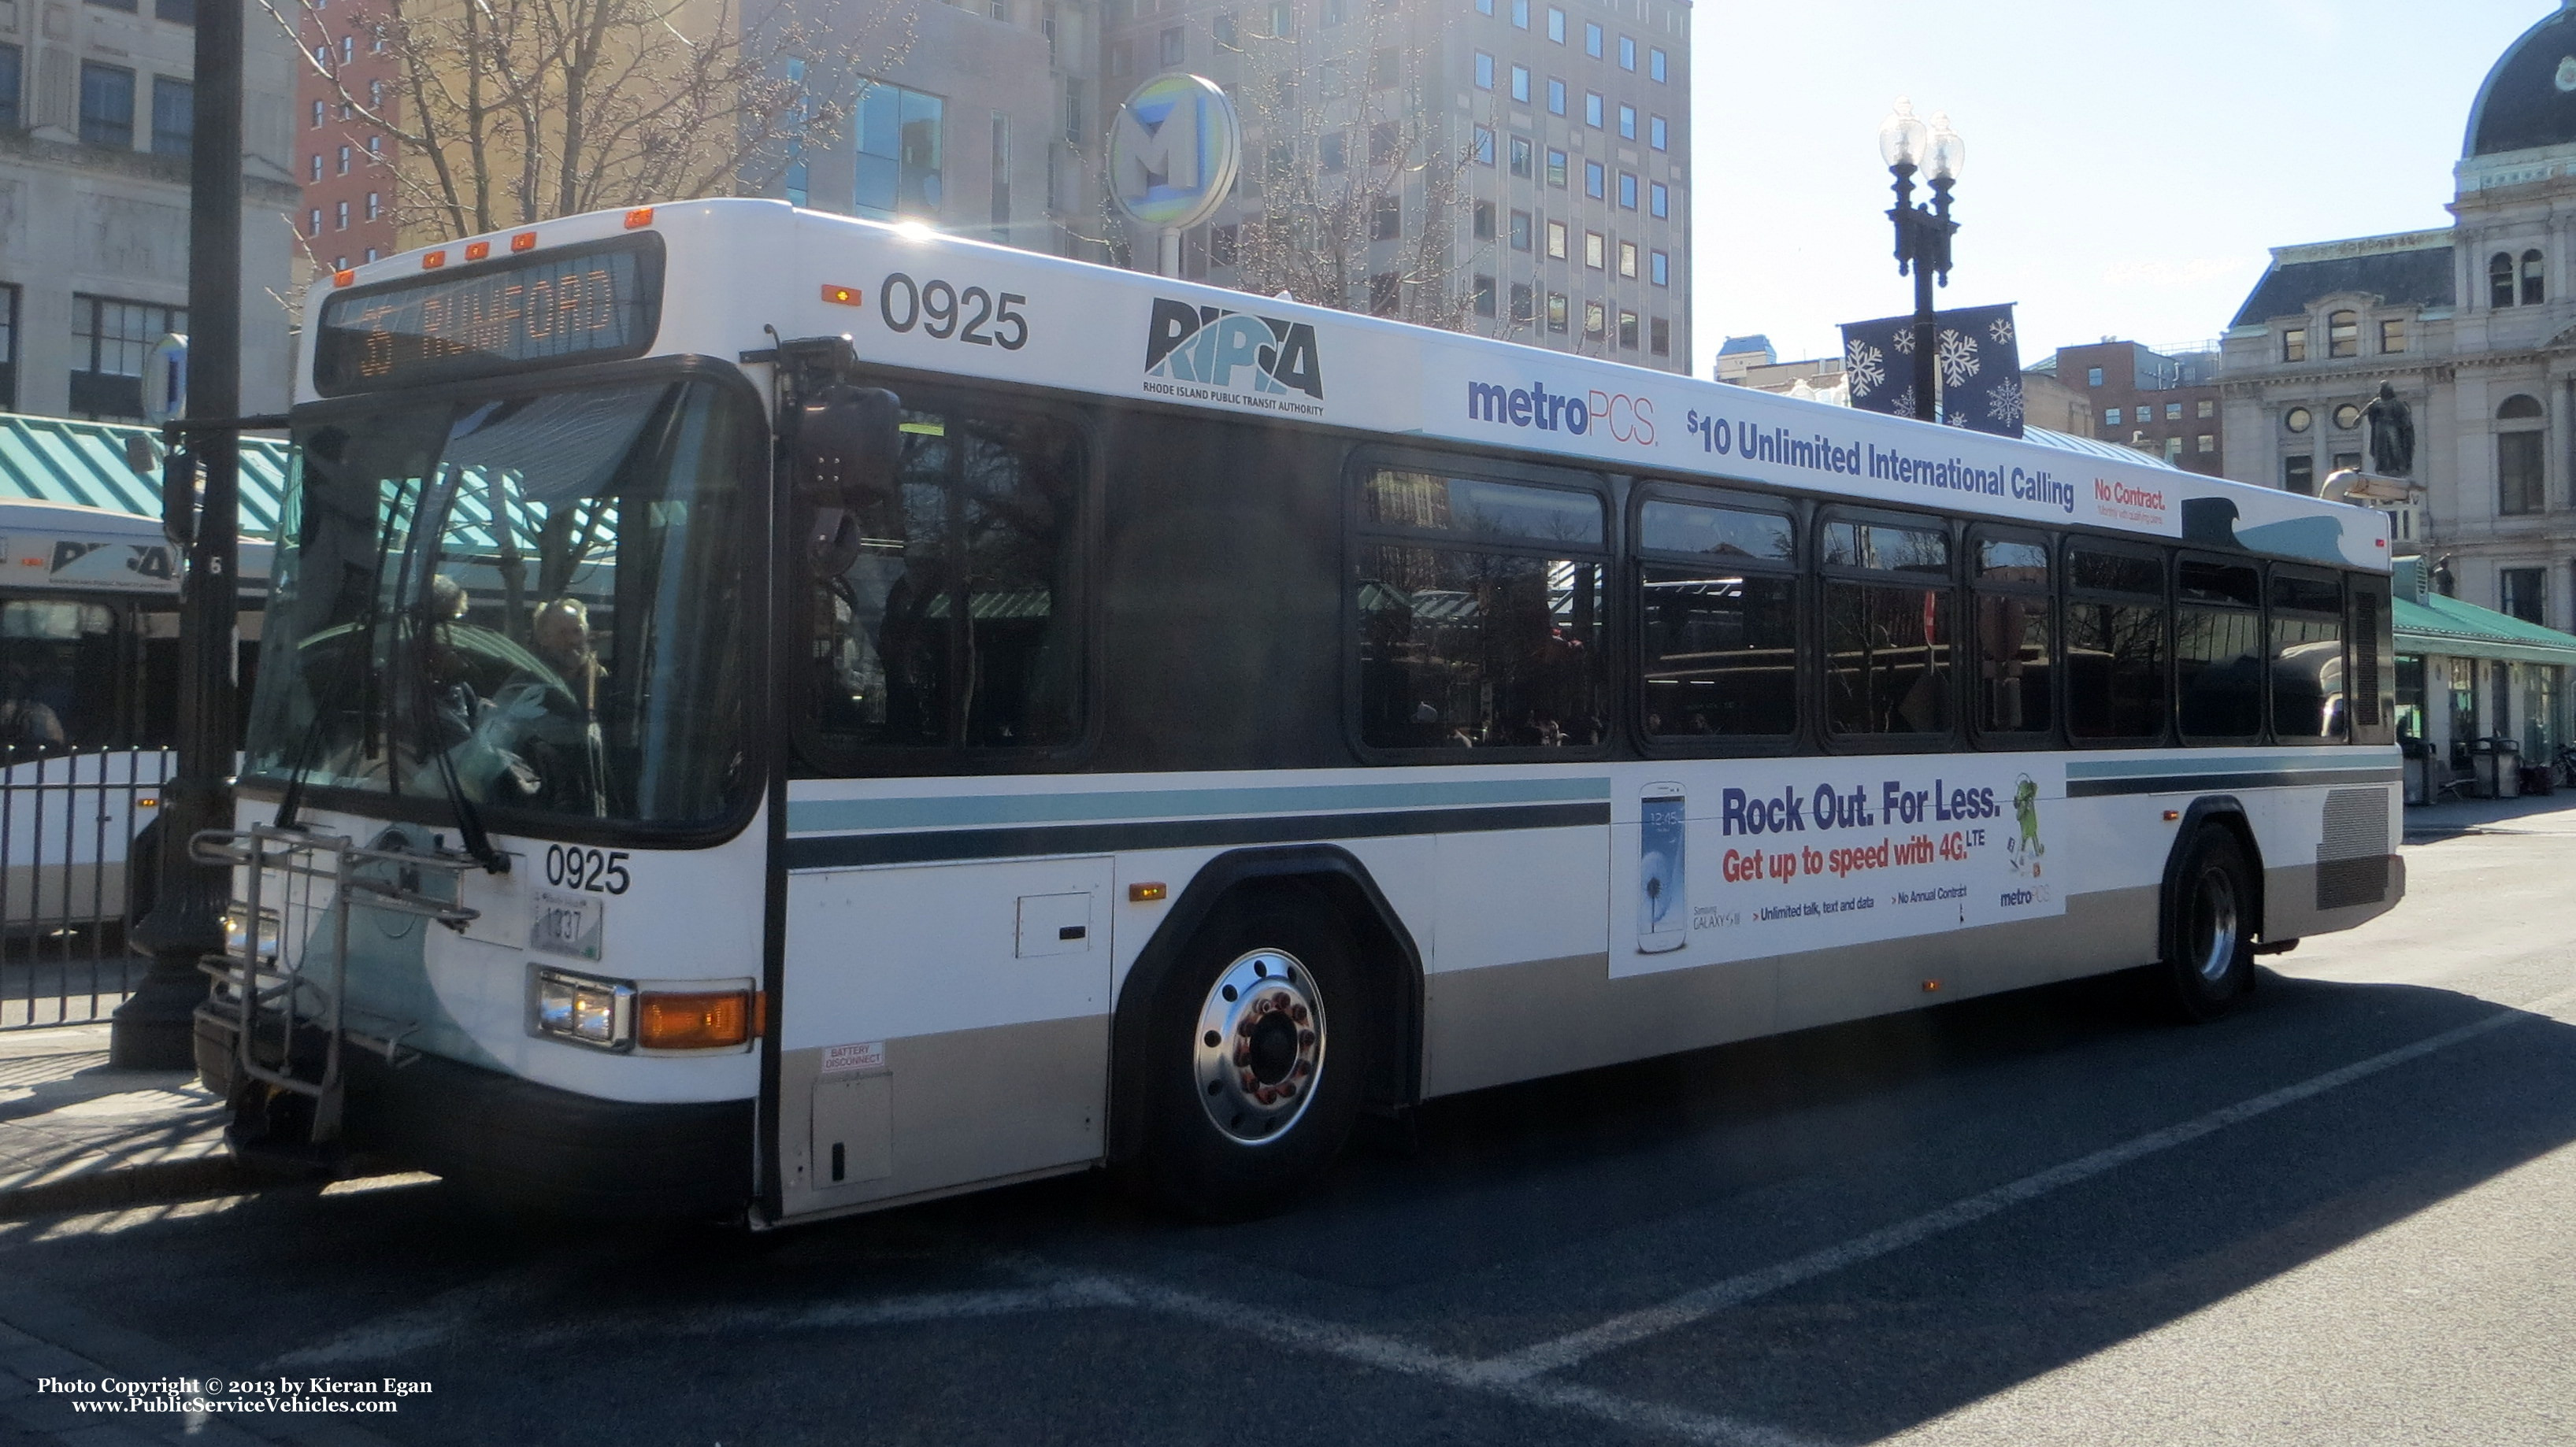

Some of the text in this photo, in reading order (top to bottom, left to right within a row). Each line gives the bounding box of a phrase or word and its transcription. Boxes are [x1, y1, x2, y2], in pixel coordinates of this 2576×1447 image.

[1116, 94, 1199, 197] M
[423, 270, 610, 360] RUMFORD
[880, 272, 1029, 351] 0925
[1143, 296, 1325, 402] RIPTA
[1143, 381, 1325, 416] RHODE ISLAND PUBLIC TRANSIT AUTHORITY
[1686, 408, 2075, 514] $10 Unlimited International Calling
[2094, 477, 2166, 511] No Contract.
[1650, 811, 1677, 826] 12:45
[1722, 779, 2000, 836] Rock Out. For Less.
[547, 843, 631, 895] 0925
[1722, 848, 1764, 883] Get
[1769, 852, 1796, 884] up
[1801, 845, 1823, 875] to
[1829, 837, 1889, 879] speed
[1894, 835, 1934, 866] with
[1760, 895, 1874, 921] Unlimited talk, text and data
[1897, 883, 1967, 905] No Annual Contract
[826, 1053, 880, 1068] DISCONNECT
[831, 1045, 870, 1057] BATTERY
